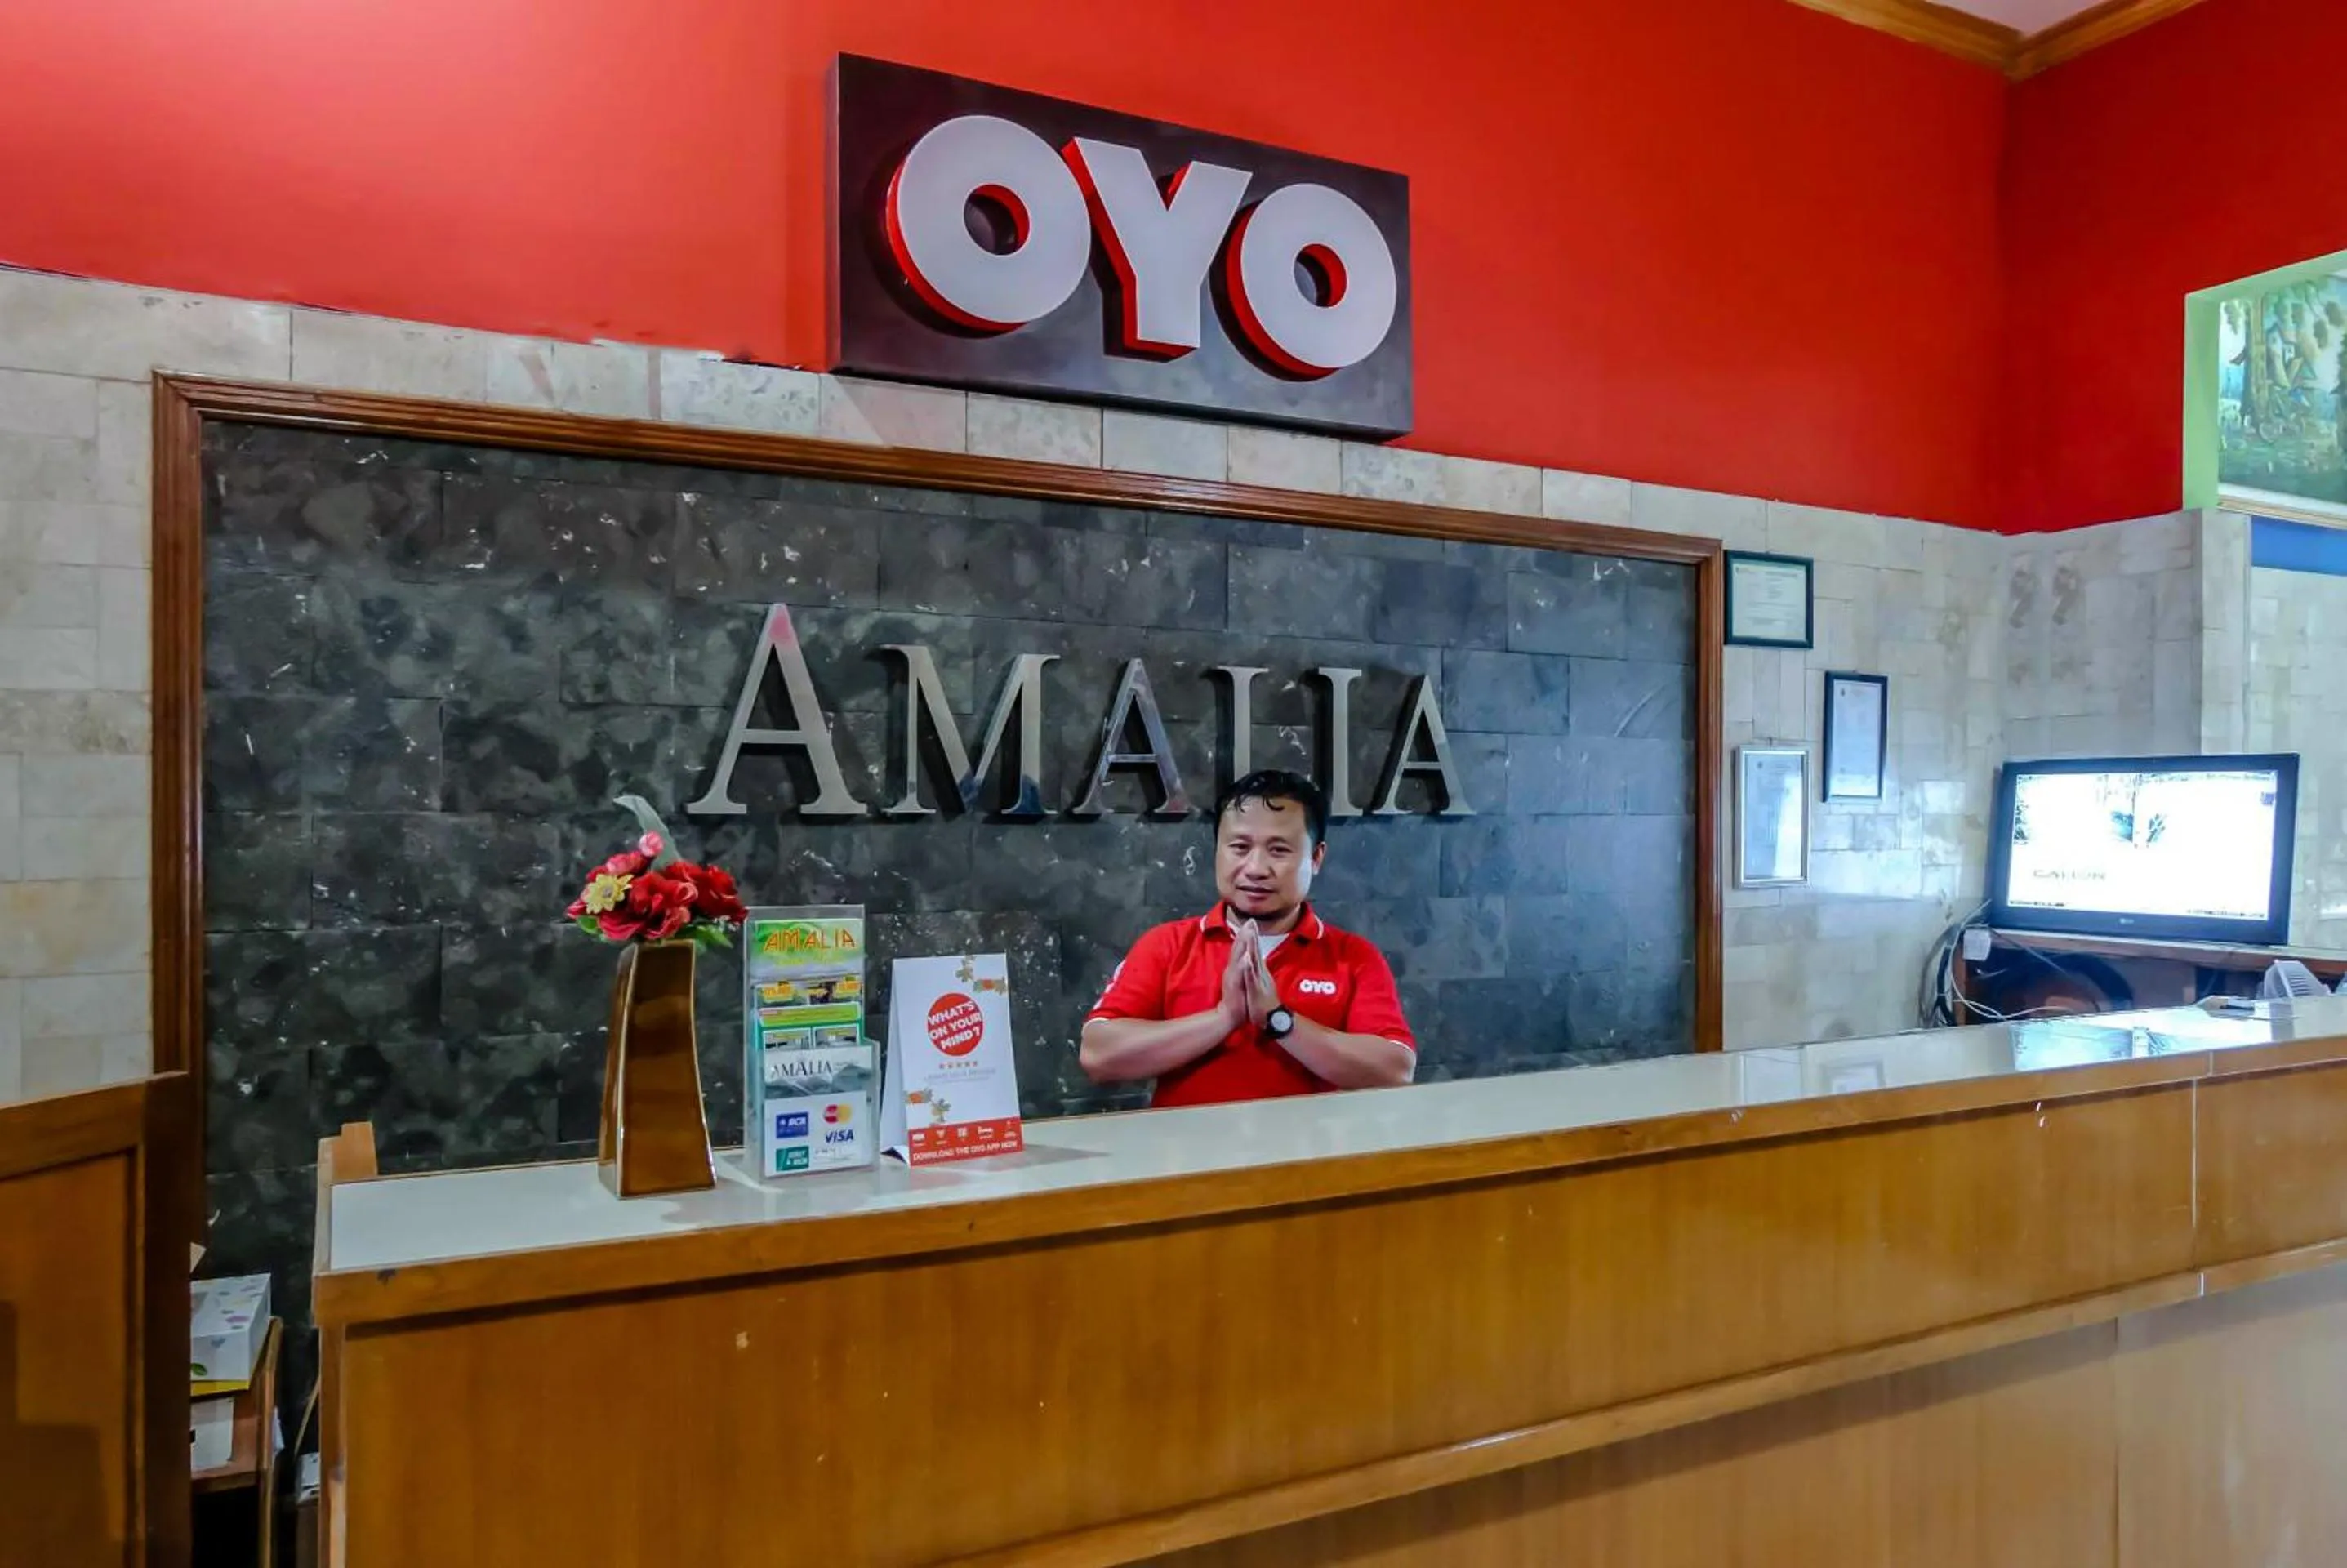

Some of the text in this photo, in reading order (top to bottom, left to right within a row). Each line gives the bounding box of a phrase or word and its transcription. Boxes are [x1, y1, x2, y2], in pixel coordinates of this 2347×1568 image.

[886, 114, 1396, 369] OYO
[764, 928, 856, 952] AMALIA
[1300, 979, 1336, 995] OYO
[928, 1000, 975, 1026] WHAT'S
[929, 1012, 982, 1040] ON YOUR
[771, 1061, 833, 1077] AMALIA
[825, 1129, 854, 1143] VISA
[912, 1147, 954, 1160] DOWNLOAD
[955, 1146, 969, 1155] THE
[986, 1142, 1000, 1152] APP
